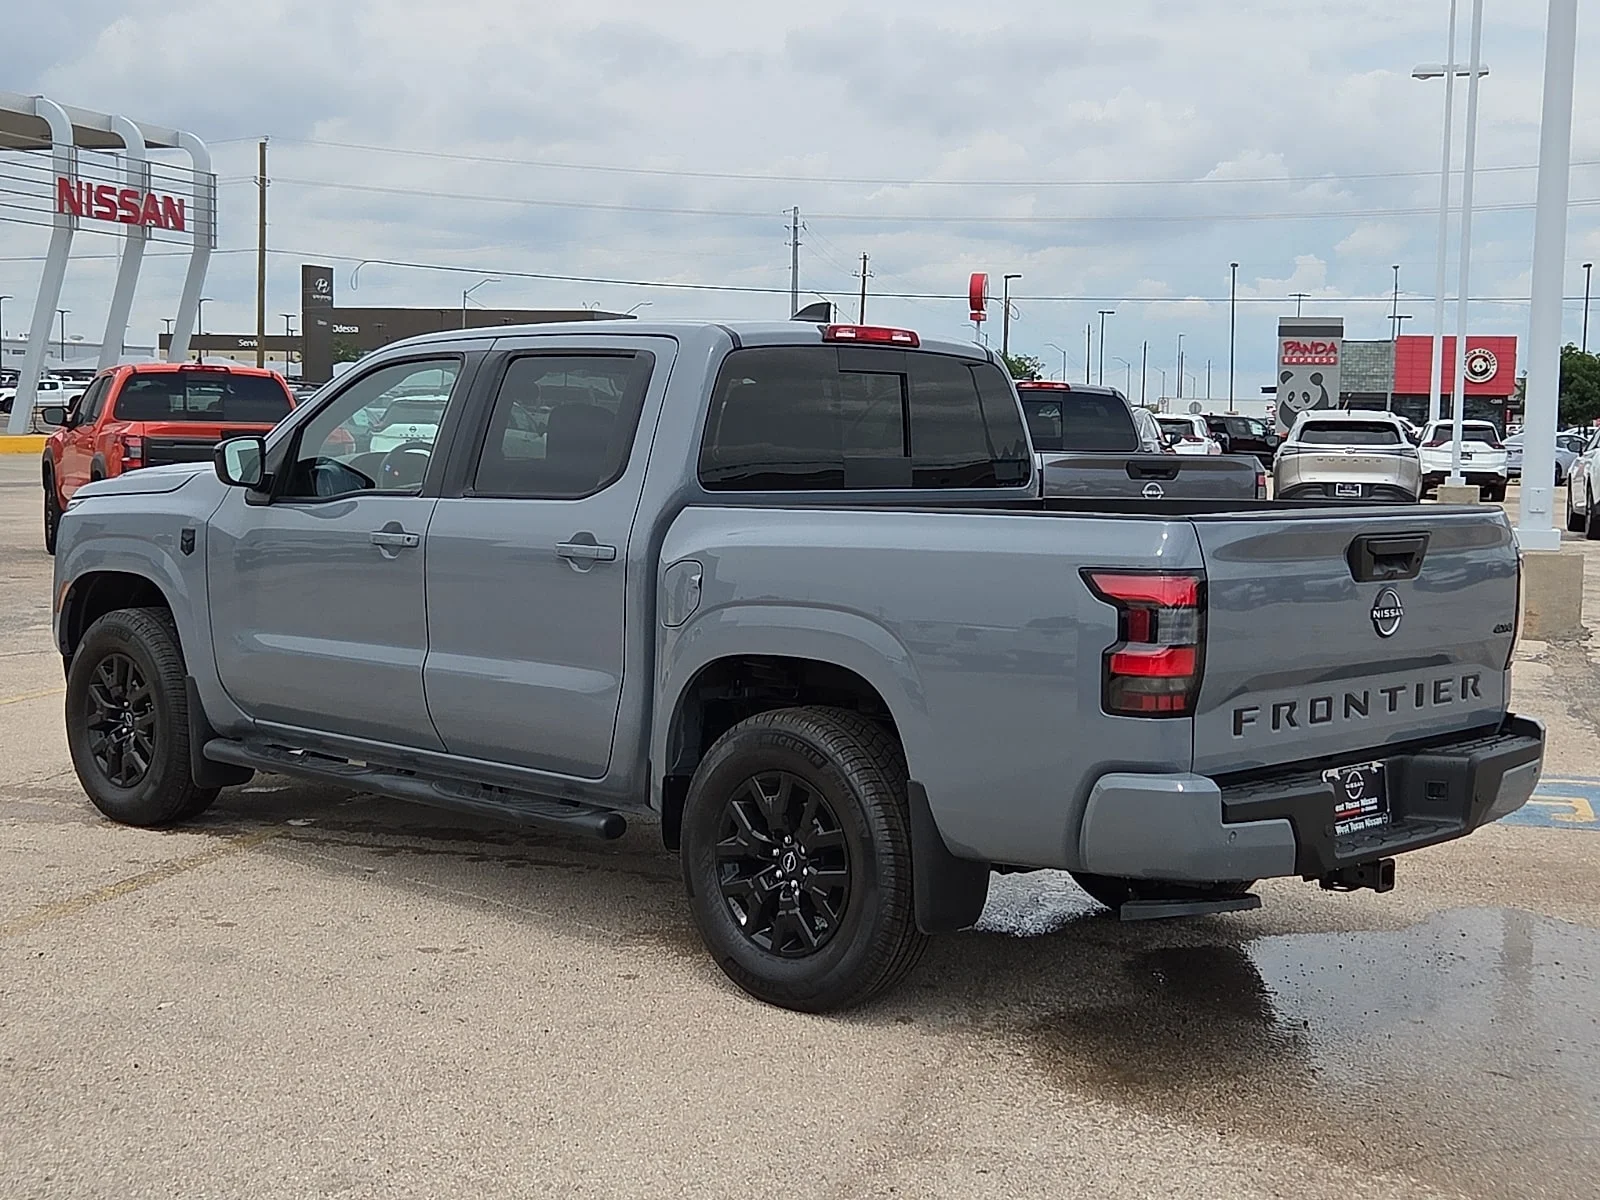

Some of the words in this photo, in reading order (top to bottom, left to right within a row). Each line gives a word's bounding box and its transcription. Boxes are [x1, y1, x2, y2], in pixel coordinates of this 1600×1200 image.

[57, 176, 185, 232] NISSAN
[333, 324, 359, 333] Odessa
[1283, 341, 1338, 356] PANDA
[1284, 356, 1335, 364] EXPRESS
[1478, 349, 1496, 366] EXPRESS
[1372, 607, 1404, 619] NISSAN
[1232, 674, 1481, 738] FRONTIER
[1345, 801, 1360, 810] Texas
[1360, 797, 1378, 806] Nissan
[1335, 823, 1349, 835] West
[1349, 821, 1365, 832] Texas
[1364, 816, 1383, 828] Nissan
